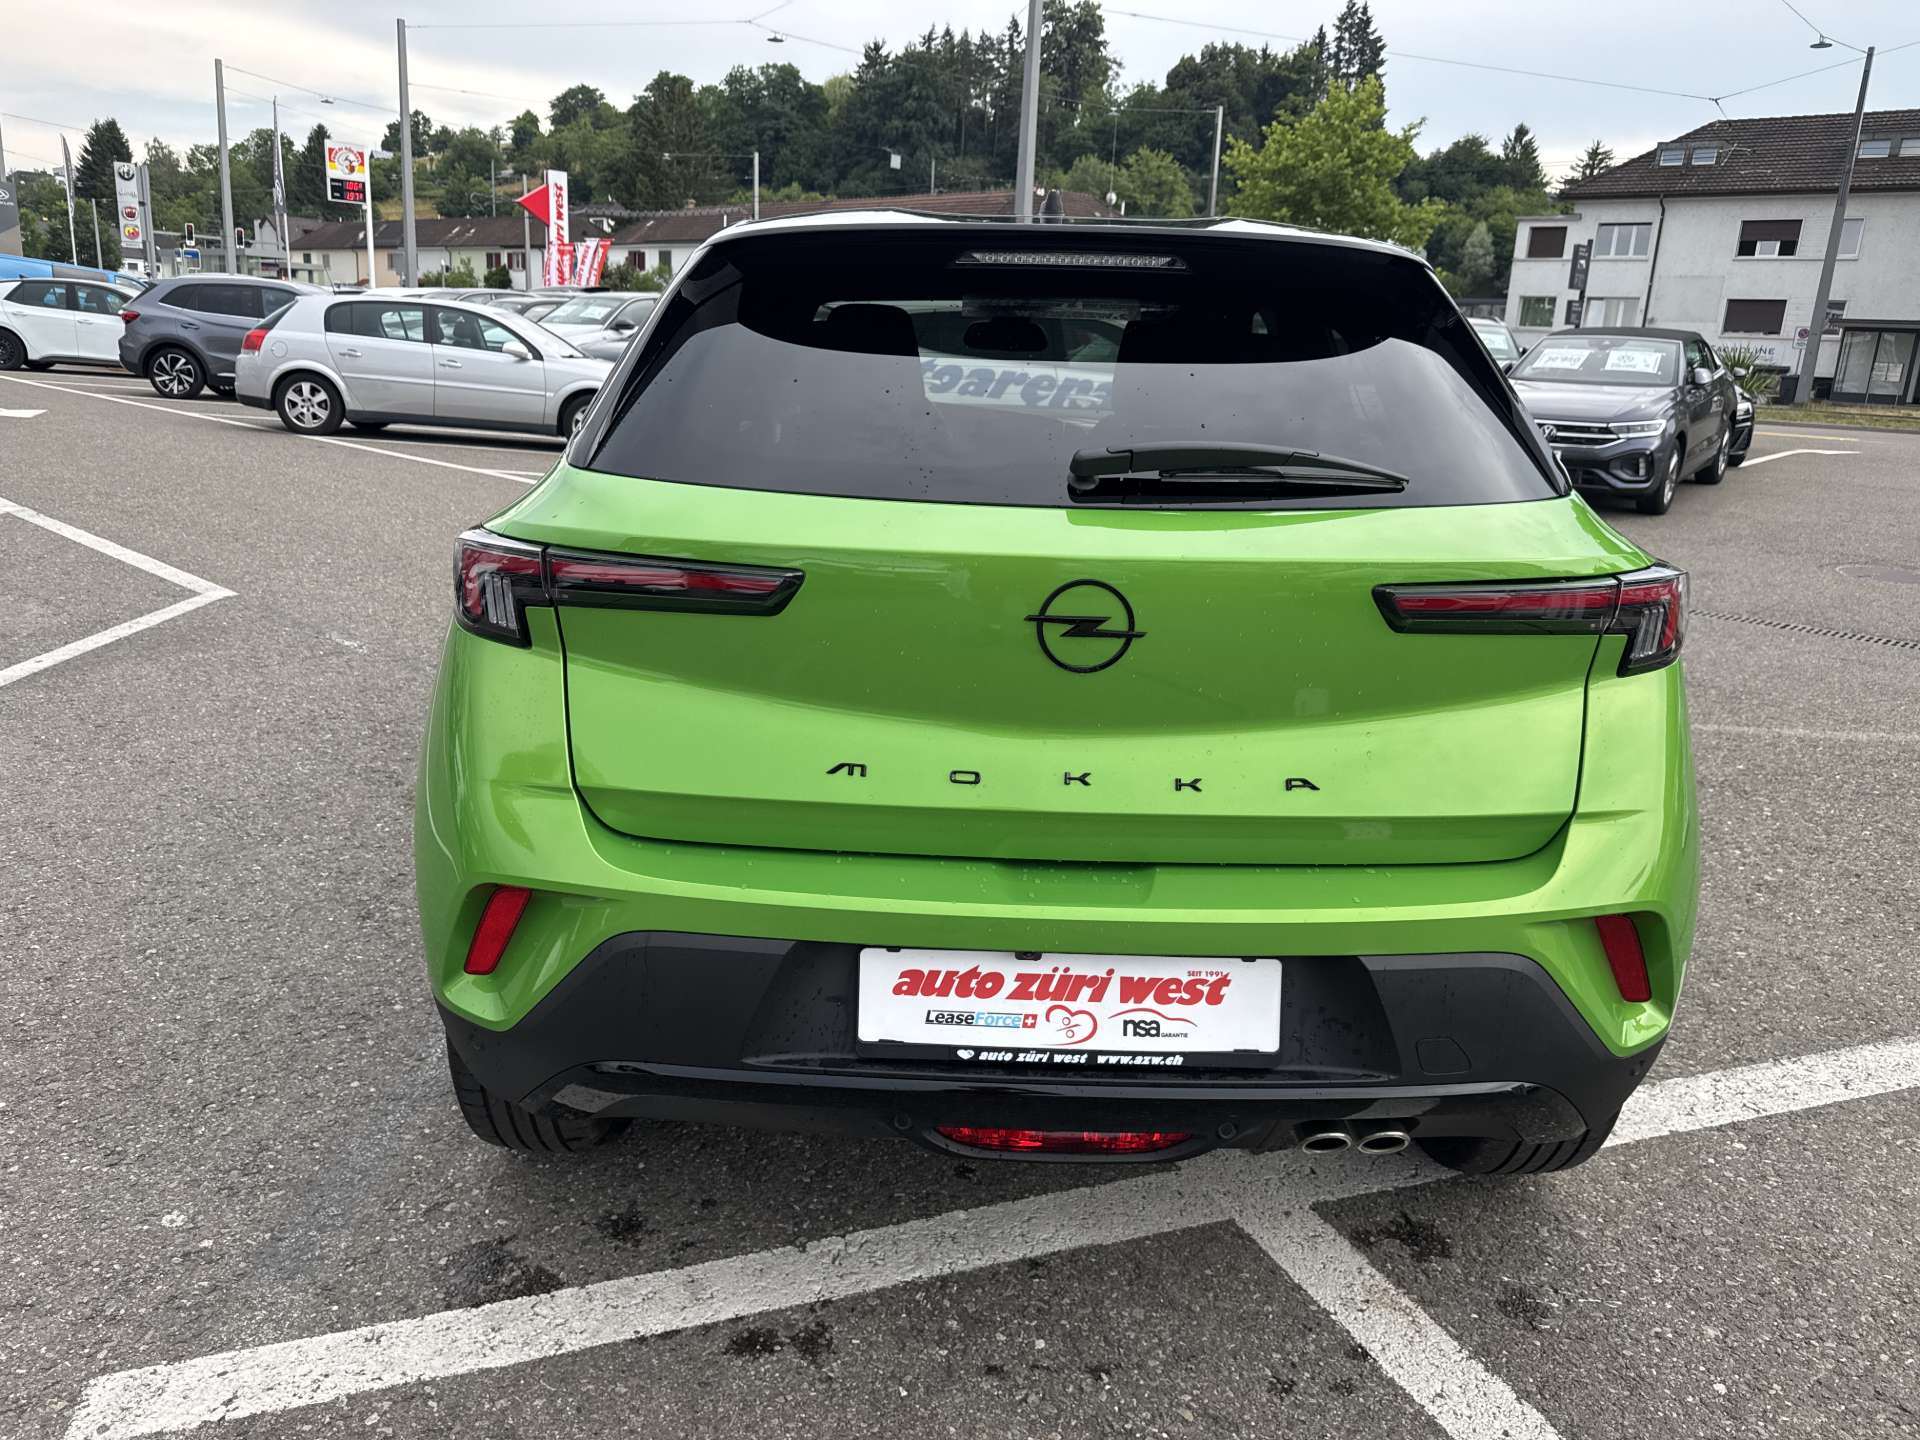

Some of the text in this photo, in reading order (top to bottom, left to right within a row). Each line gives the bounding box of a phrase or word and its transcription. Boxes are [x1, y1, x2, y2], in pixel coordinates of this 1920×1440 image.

[825, 762, 1321, 793] MOKKA
[892, 965, 1232, 1006] auto züri west
[925, 1010, 1022, 1027] LeaseForce
[1123, 1019, 1161, 1038] nsa
[978, 1050, 1184, 1066] auto züri west www.azw.ch
